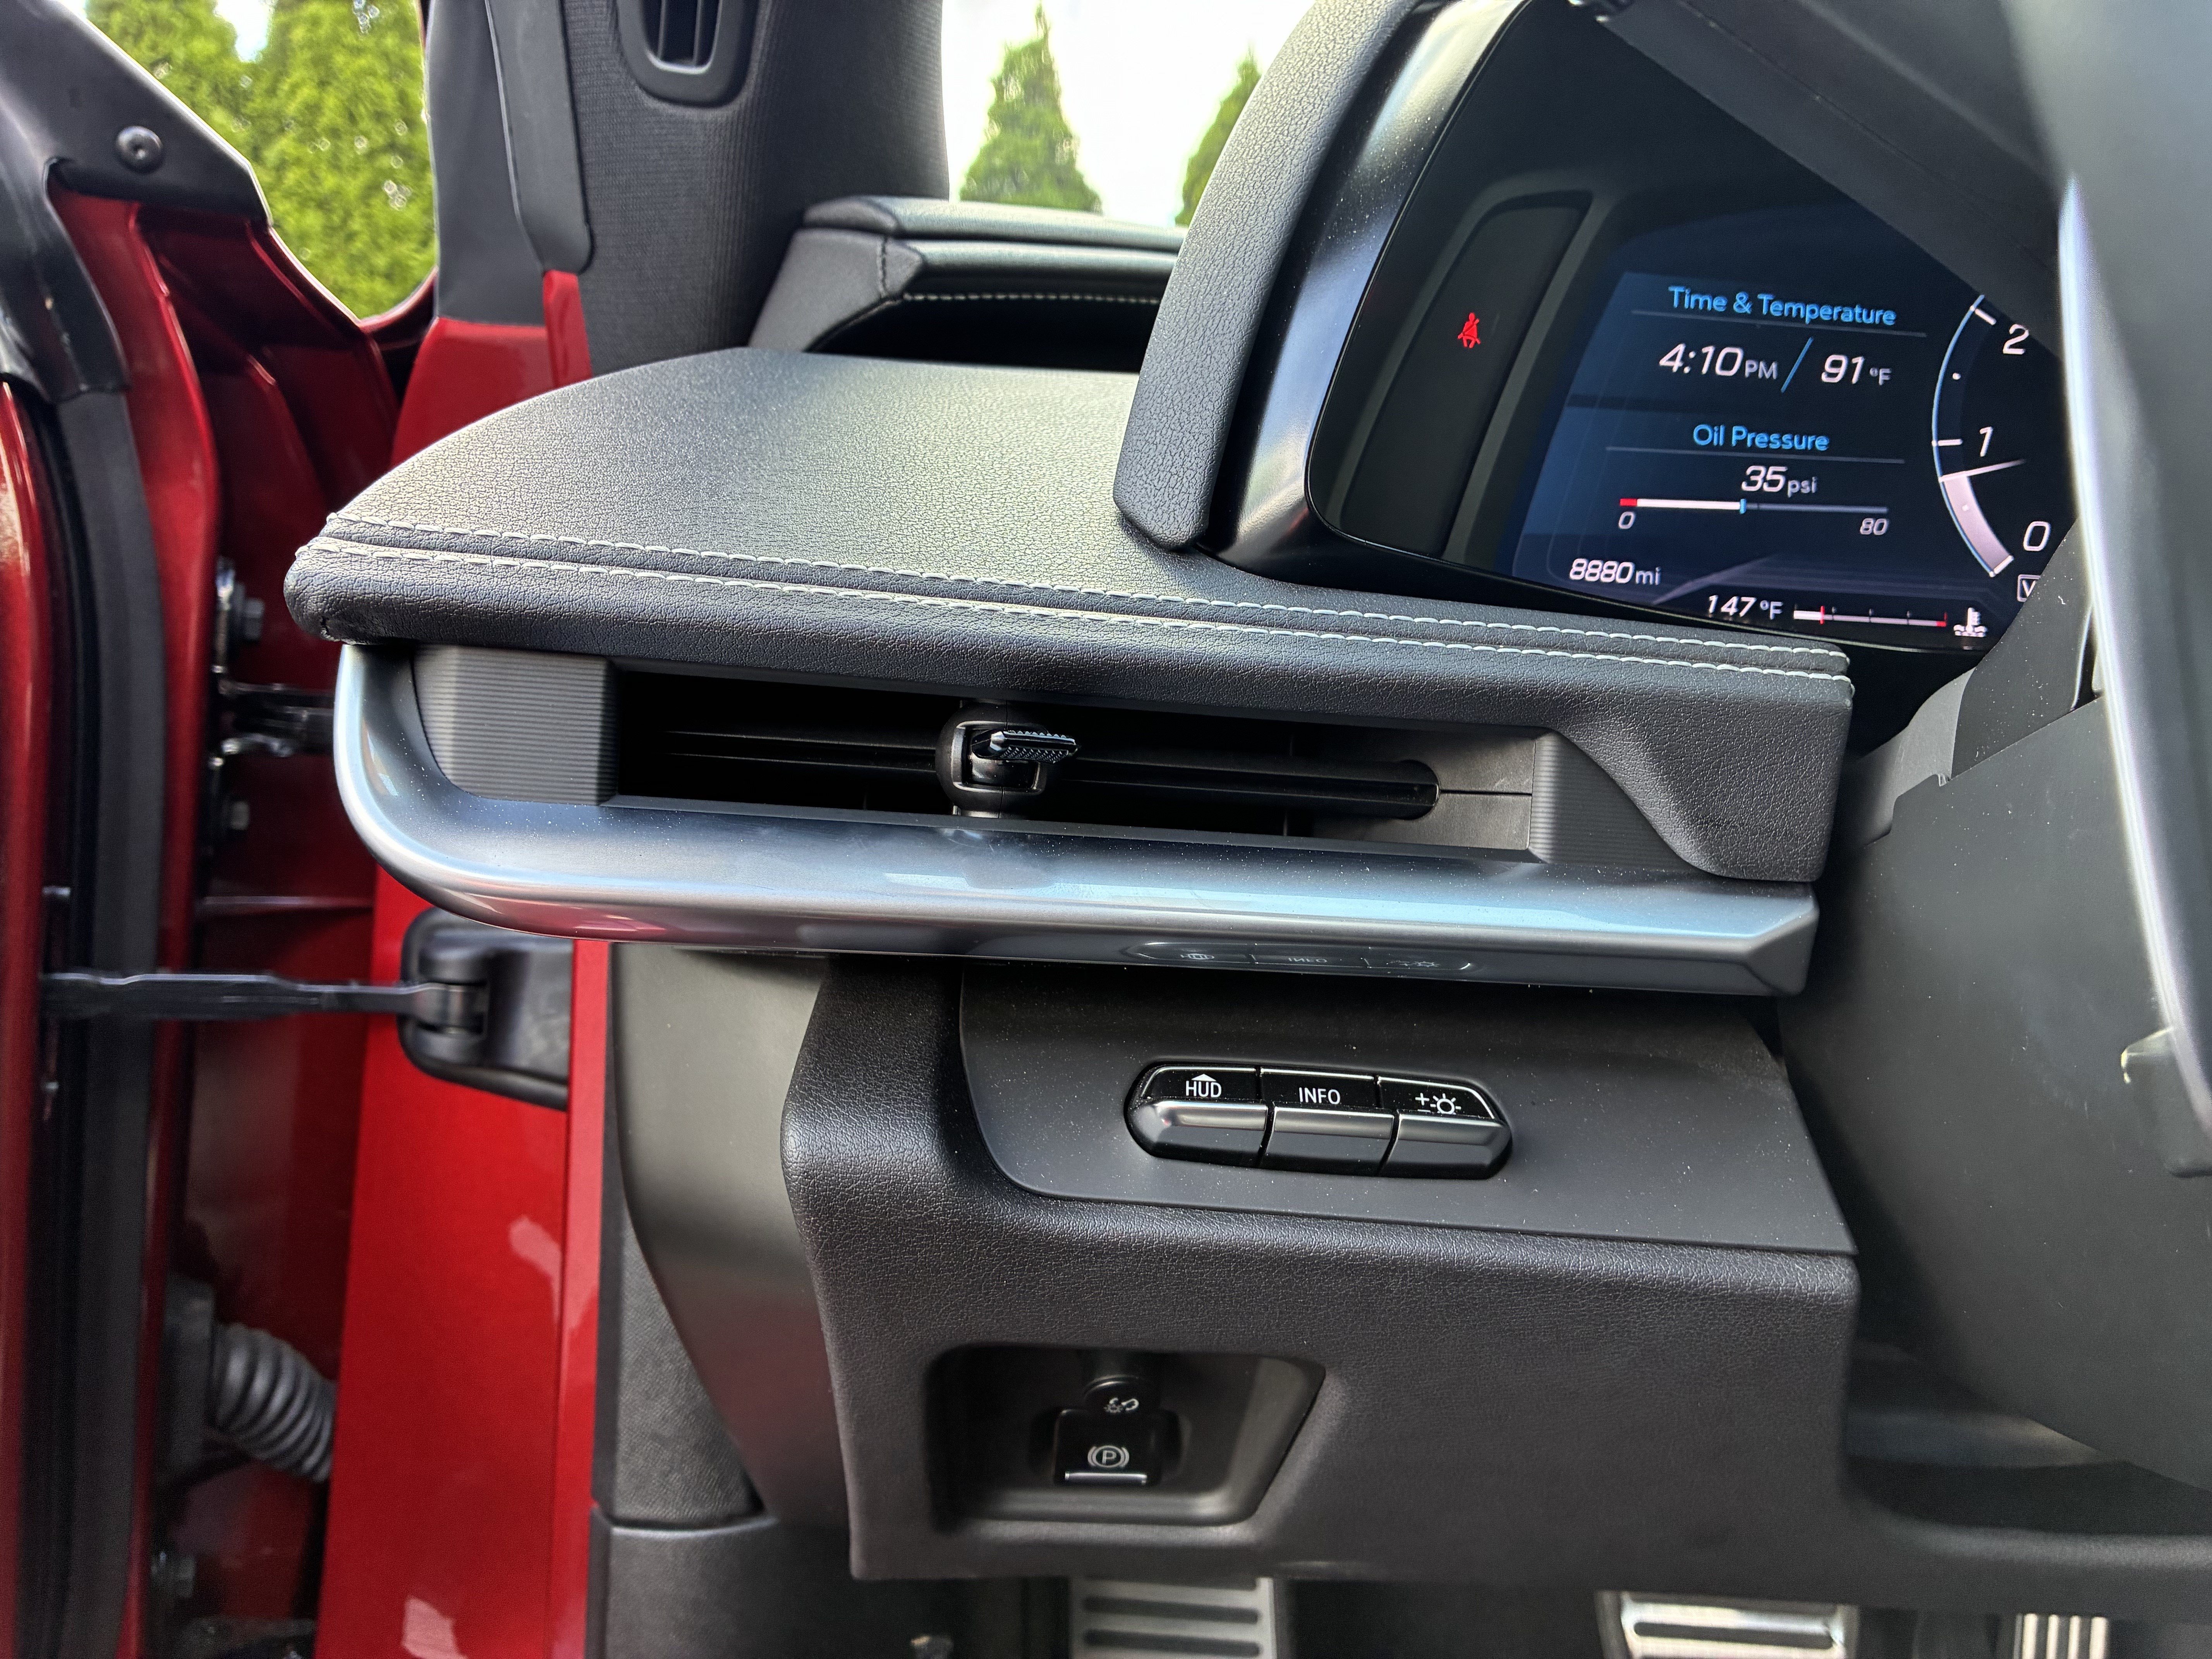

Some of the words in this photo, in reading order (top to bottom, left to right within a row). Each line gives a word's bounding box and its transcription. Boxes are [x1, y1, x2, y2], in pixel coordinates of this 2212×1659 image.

[1668, 285, 1728, 312] Time
[1733, 292, 1753, 314] &
[1757, 293, 1897, 326] Temperature
[2002, 324, 2029, 354] 2
[1693, 424, 1725, 447] Oil
[1731, 425, 1830, 451] Pressure
[1979, 426, 1994, 457] 1
[1618, 511, 1636, 529] 0
[1859, 517, 1889, 536] 80
[2023, 521, 2051, 551] 0
[1708, 595, 1757, 617] 147
[1185, 1080, 1222, 1098] HUD
[1298, 1087, 1341, 1105] INFO
